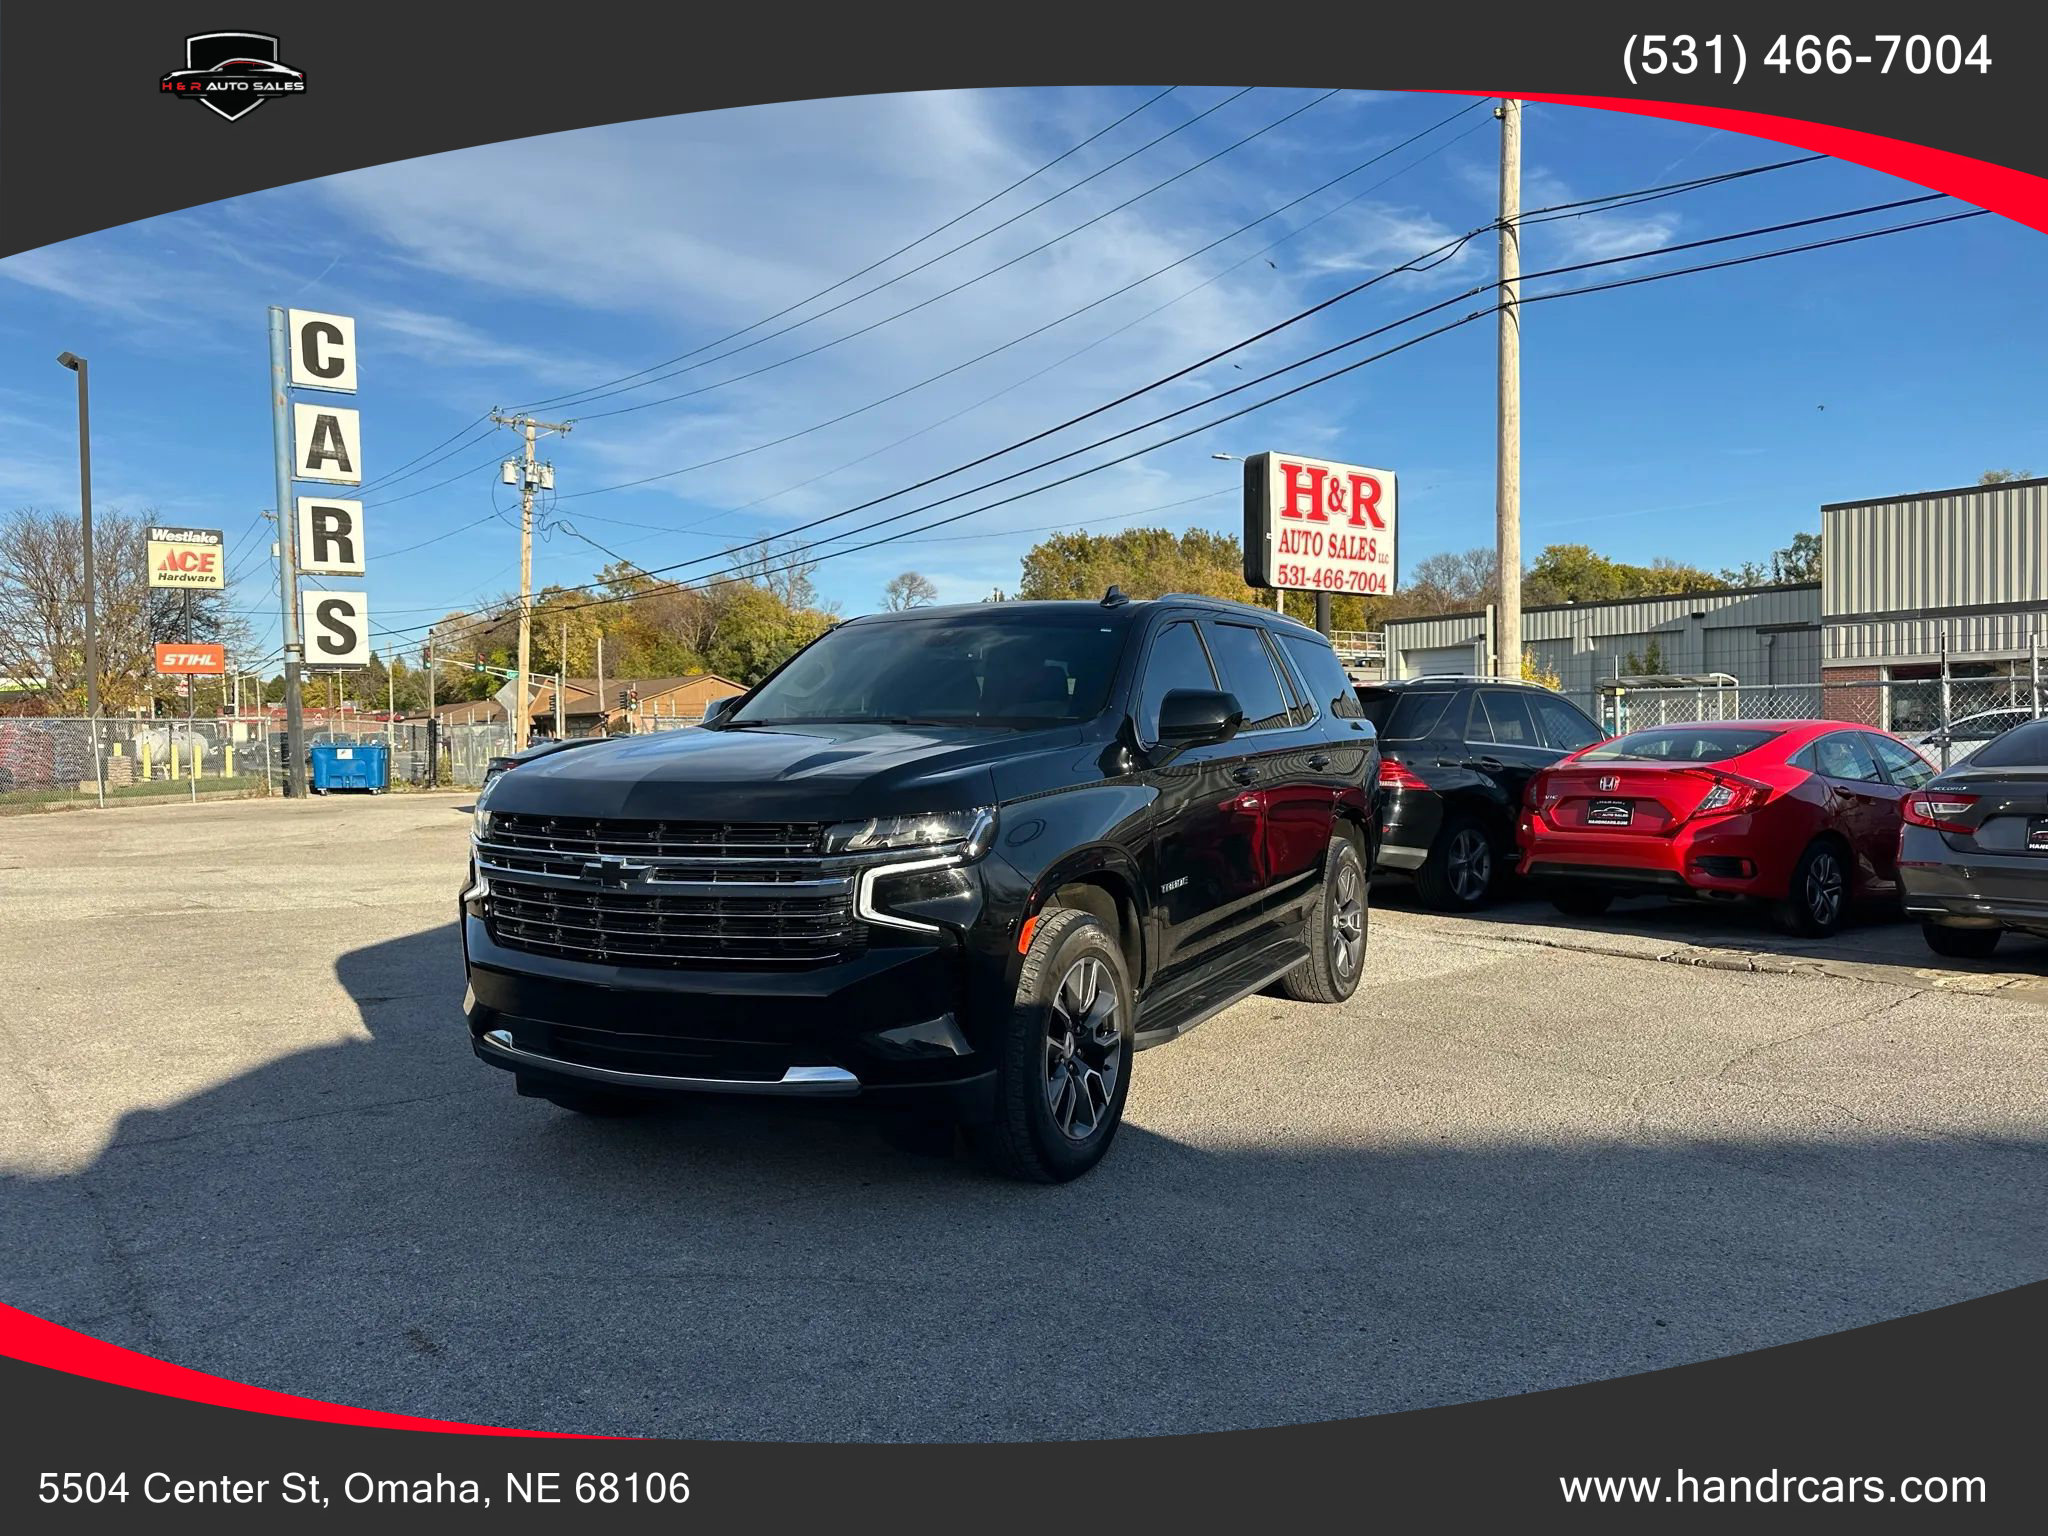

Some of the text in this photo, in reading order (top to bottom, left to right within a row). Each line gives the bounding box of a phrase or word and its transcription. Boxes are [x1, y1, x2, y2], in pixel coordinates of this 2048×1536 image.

[300, 320, 358, 657] CARS
[151, 528, 219, 545] Westlake
[1278, 528, 1324, 557] AUTO
[1327, 533, 1377, 562] SALES
[157, 548, 216, 573] ACE
[158, 572, 217, 584] Hardware
[1277, 564, 1387, 593] 531-466-7004
[162, 653, 217, 667] STIHL
